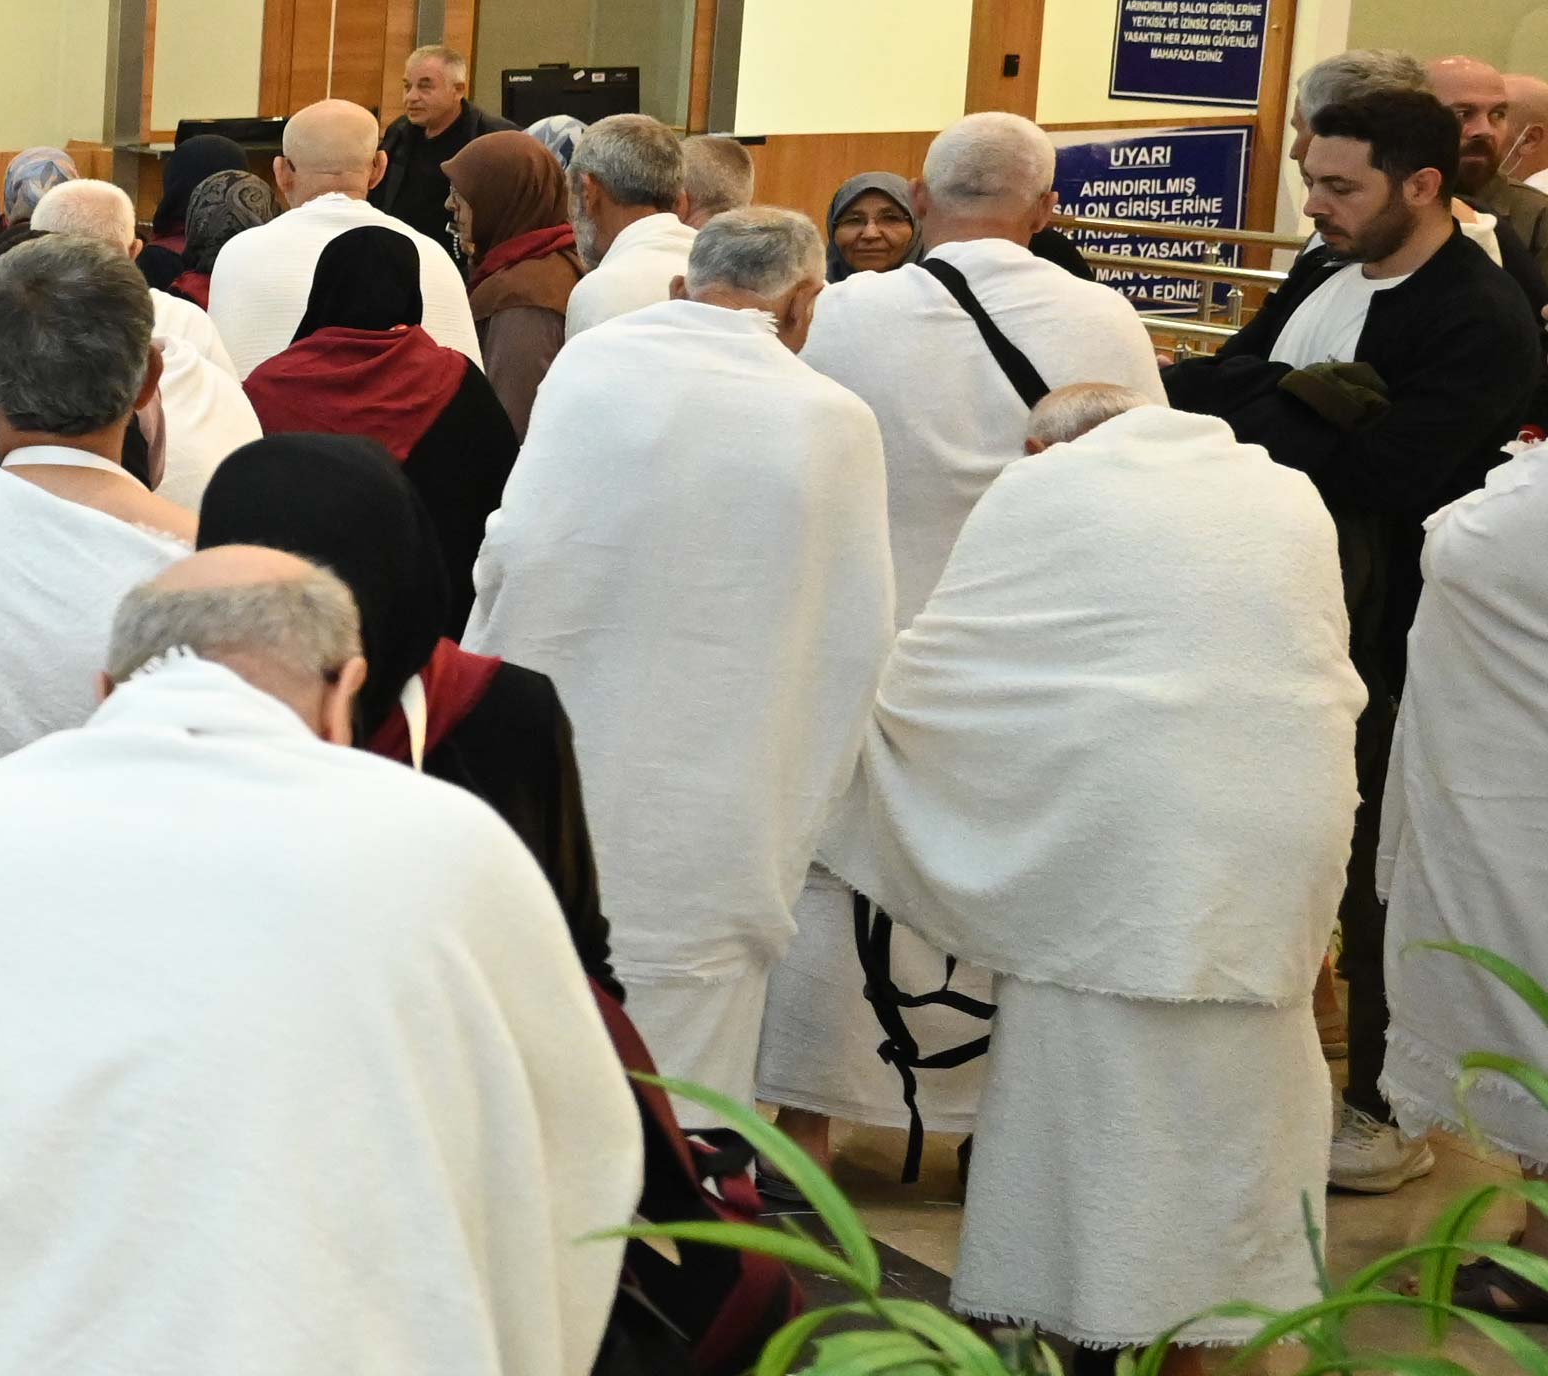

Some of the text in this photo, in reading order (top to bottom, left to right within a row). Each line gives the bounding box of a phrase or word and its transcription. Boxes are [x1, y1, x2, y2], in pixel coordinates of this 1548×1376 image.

[1126, 0, 1262, 16] ARINDIRILMIŞ SALON GİRİŞLERİNE
[1132, 14, 1252, 33] YETKİSİZ VE İZİNSİZ GEÇİŞLER
[1124, 31, 1258, 48] YASAKTIR HER ZAMAN GÜVENLİĞİ
[1150, 48, 1223, 62] MAHAFAZA EDİNİZ
[1110, 145, 1171, 167] UYARI
[1080, 177, 1196, 197] ARINDIRILMIŞ
[1115, 198, 1222, 219] GİRİŞLERİNE
